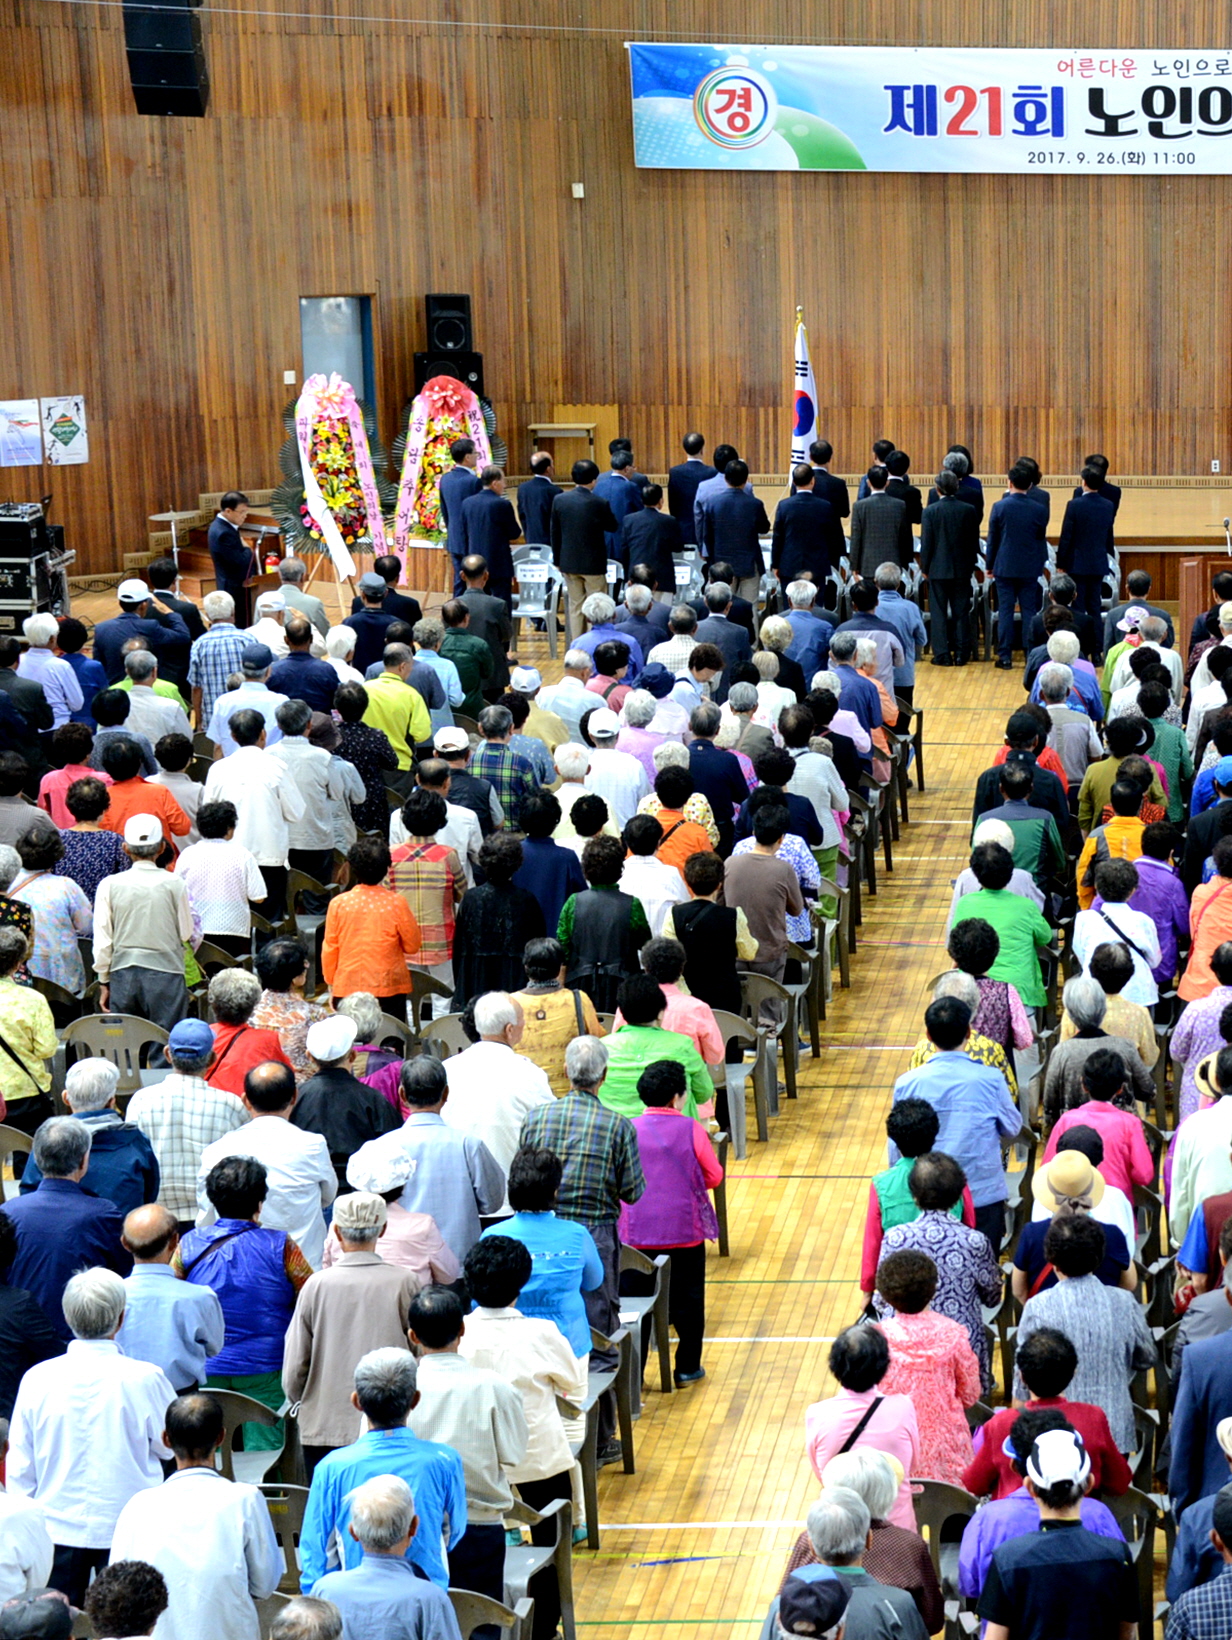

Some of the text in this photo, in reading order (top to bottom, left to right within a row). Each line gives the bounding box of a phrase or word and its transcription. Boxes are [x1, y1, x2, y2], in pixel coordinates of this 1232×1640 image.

[1056, 58, 1138, 79] 어른다운
[1151, 58, 1232, 79] 노인으로
[714, 86, 753, 132] 경
[883, 84, 1065, 138] 제21회
[1027, 150, 1196, 166] 2017. 9. 26.(화) 11:00
